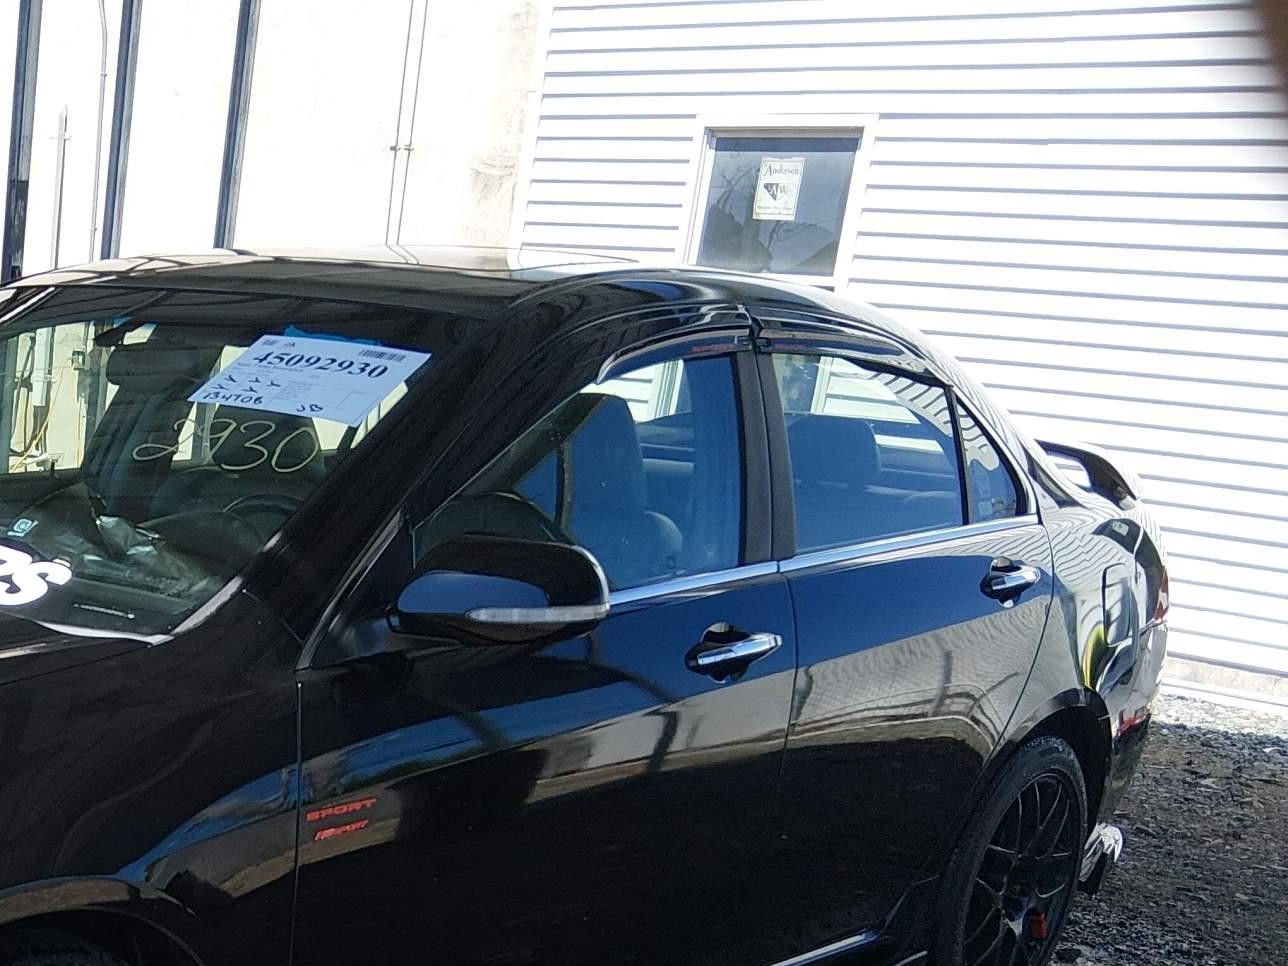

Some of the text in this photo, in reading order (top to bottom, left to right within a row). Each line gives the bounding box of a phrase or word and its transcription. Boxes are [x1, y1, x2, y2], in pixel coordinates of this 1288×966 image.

[253, 351, 390, 379] 45092930
[132, 418, 320, 473] 2930
[306, 797, 377, 822] SPORT
